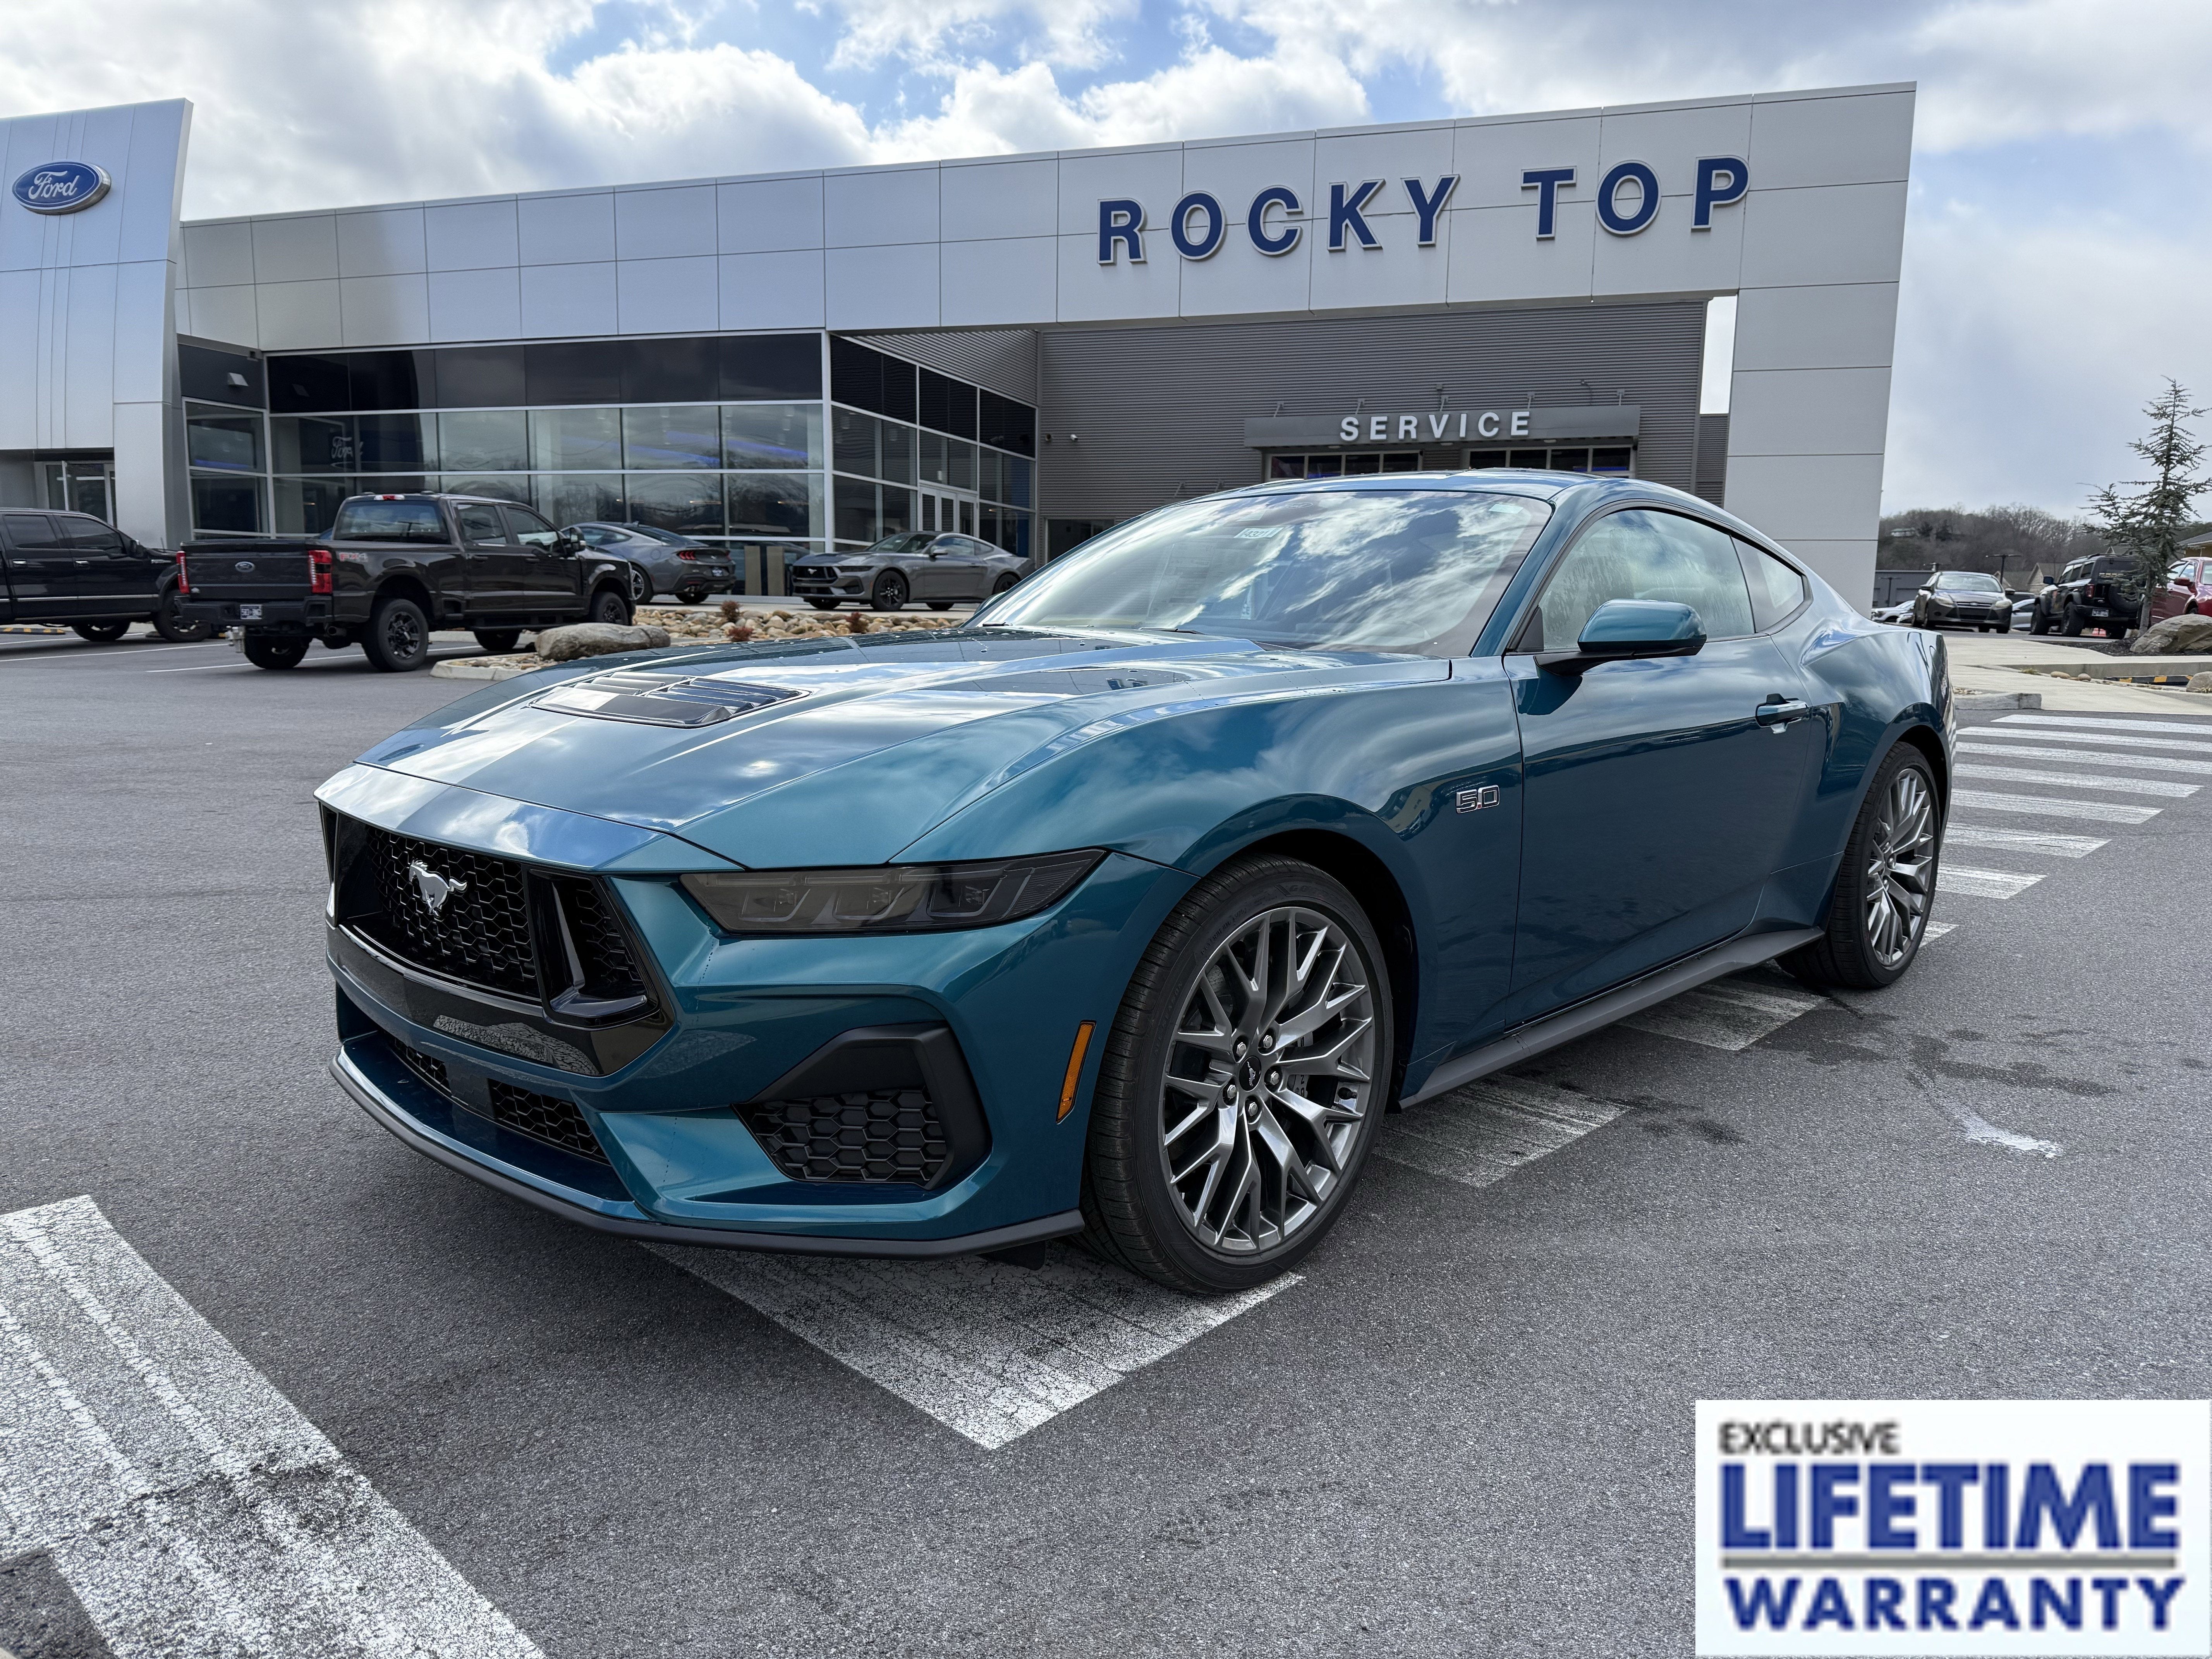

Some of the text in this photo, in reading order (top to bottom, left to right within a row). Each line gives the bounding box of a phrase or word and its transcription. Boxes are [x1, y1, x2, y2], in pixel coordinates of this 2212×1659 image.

[28, 170, 80, 199] Ford
[1097, 155, 1750, 265] ROCKY TOP
[1340, 411, 1530, 442] SERVICE
